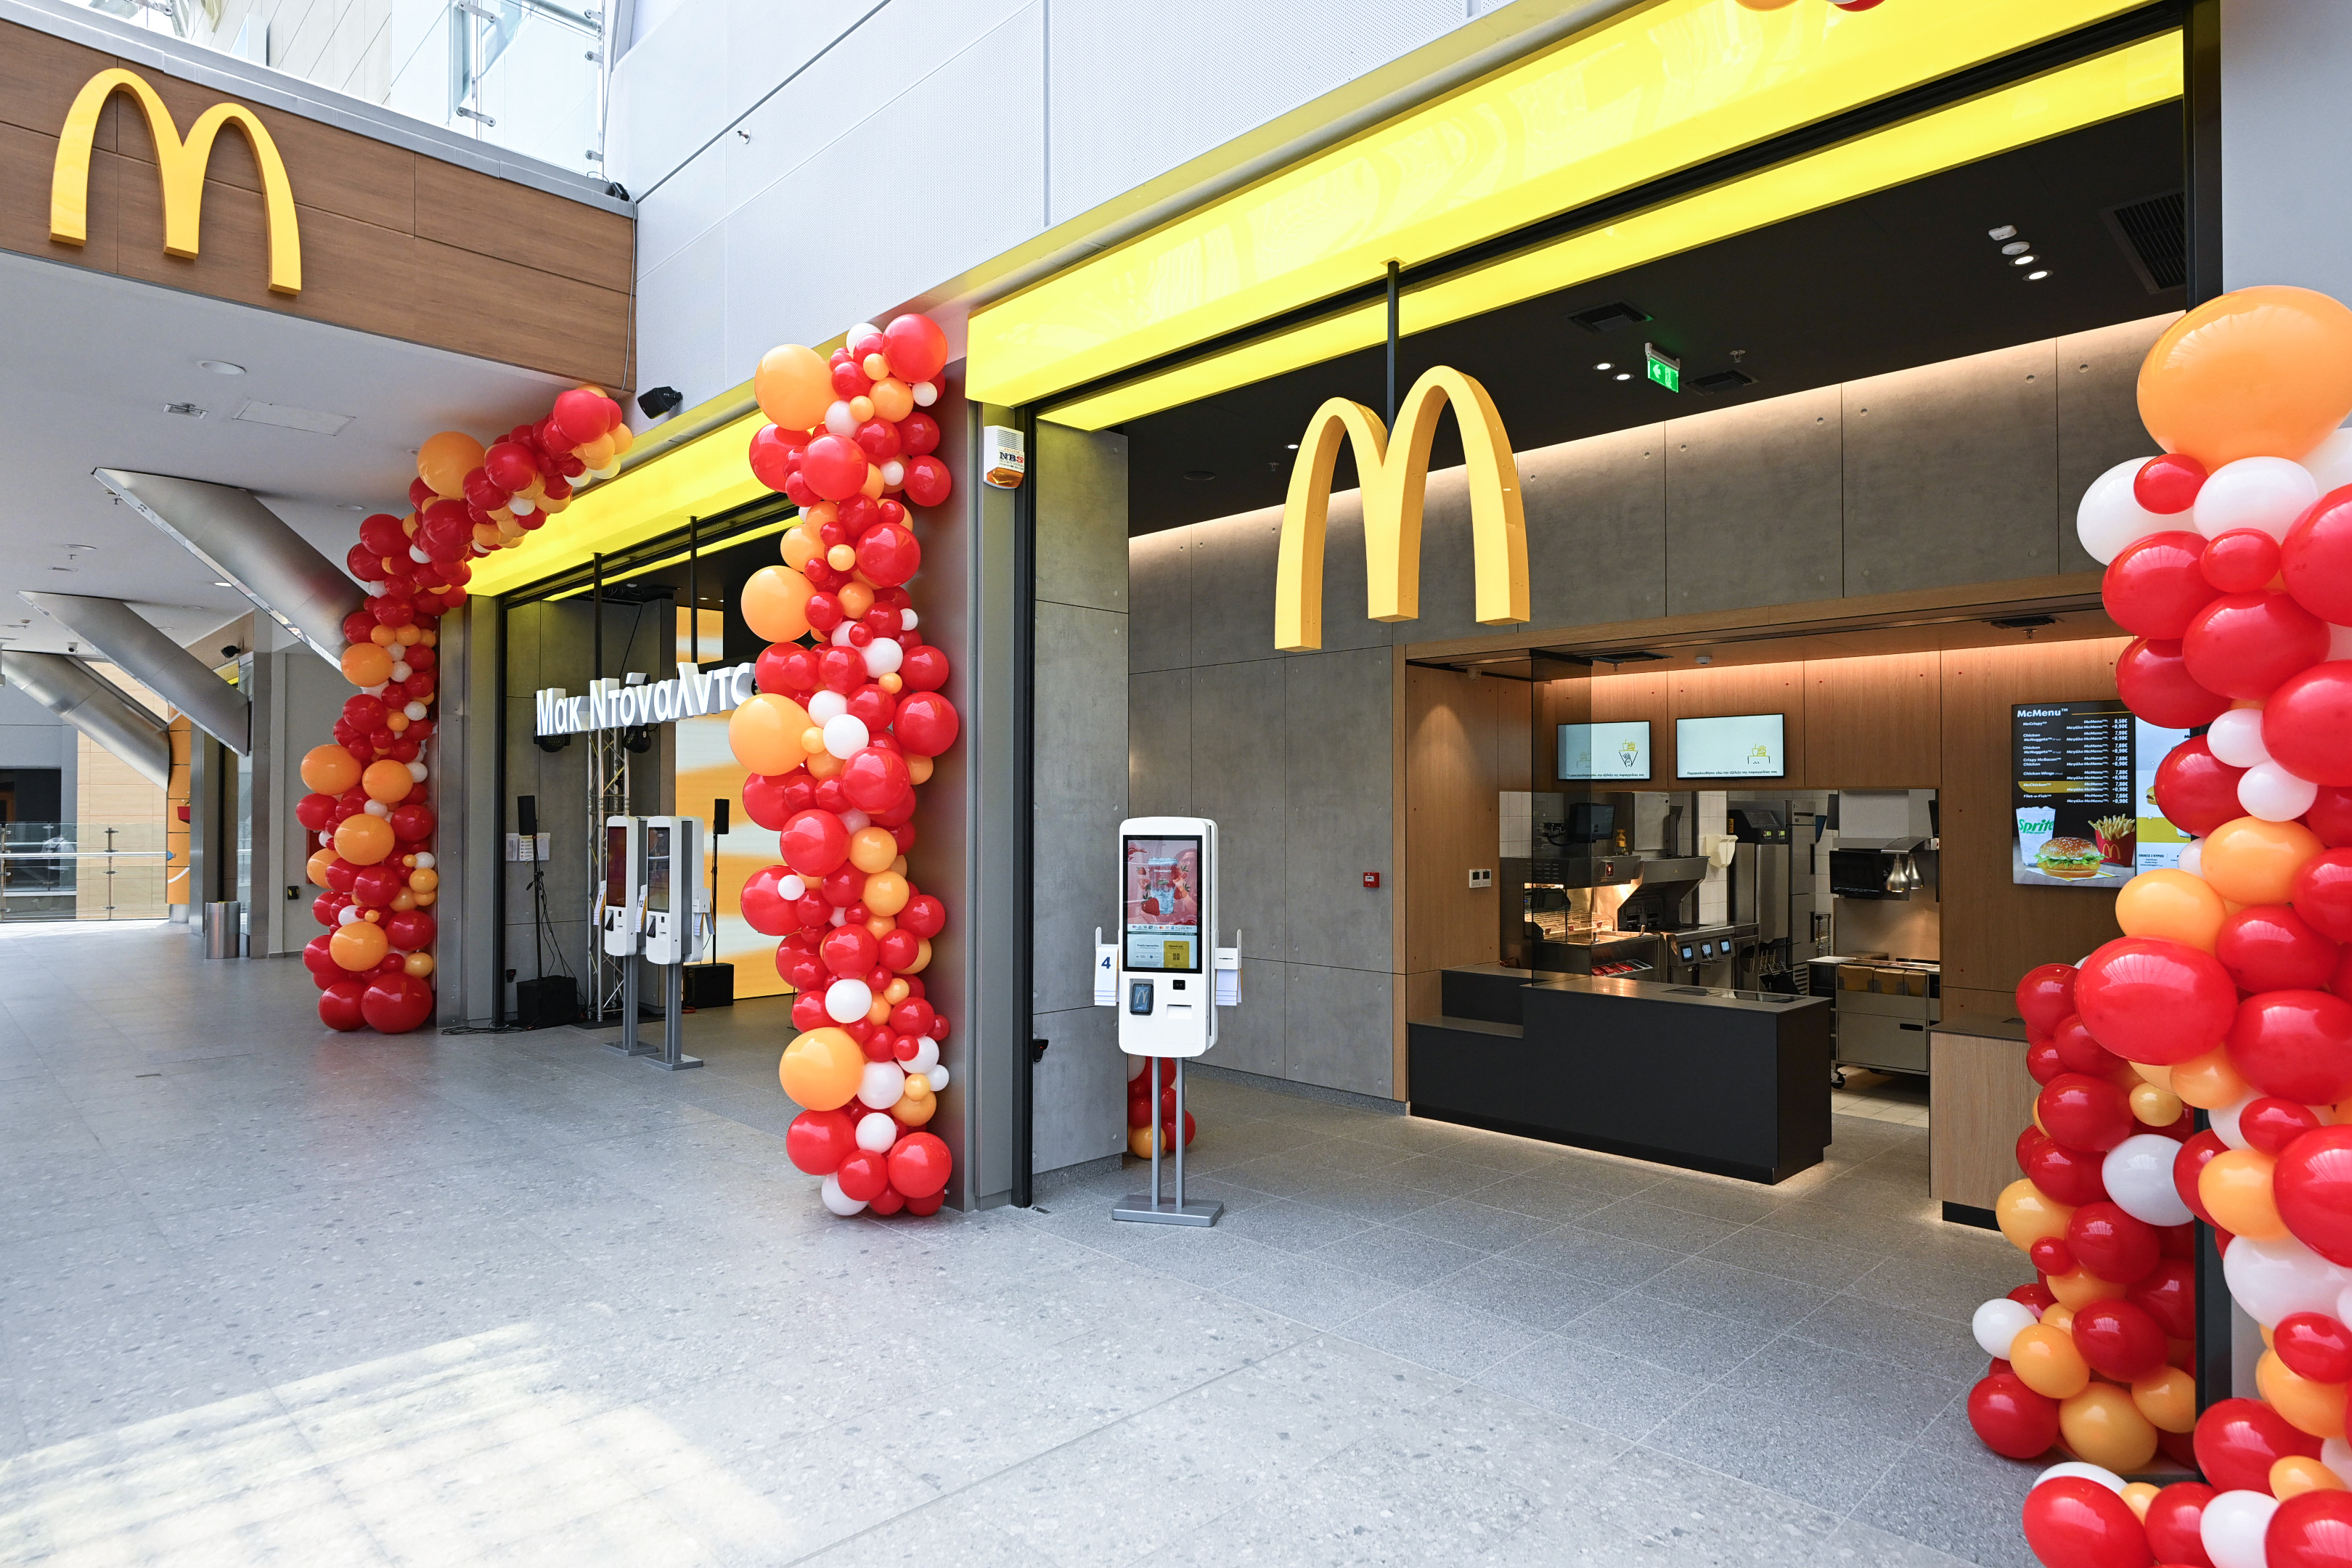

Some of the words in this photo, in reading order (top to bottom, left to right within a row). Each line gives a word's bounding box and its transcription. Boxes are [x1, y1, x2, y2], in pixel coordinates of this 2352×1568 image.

[999, 452, 1024, 464] NBS
[536, 687, 584, 736] Μακ
[589, 661, 752, 730] Ντόναλντς
[2019, 818, 2054, 833] Sprite
[1101, 957, 1111, 969] 4
